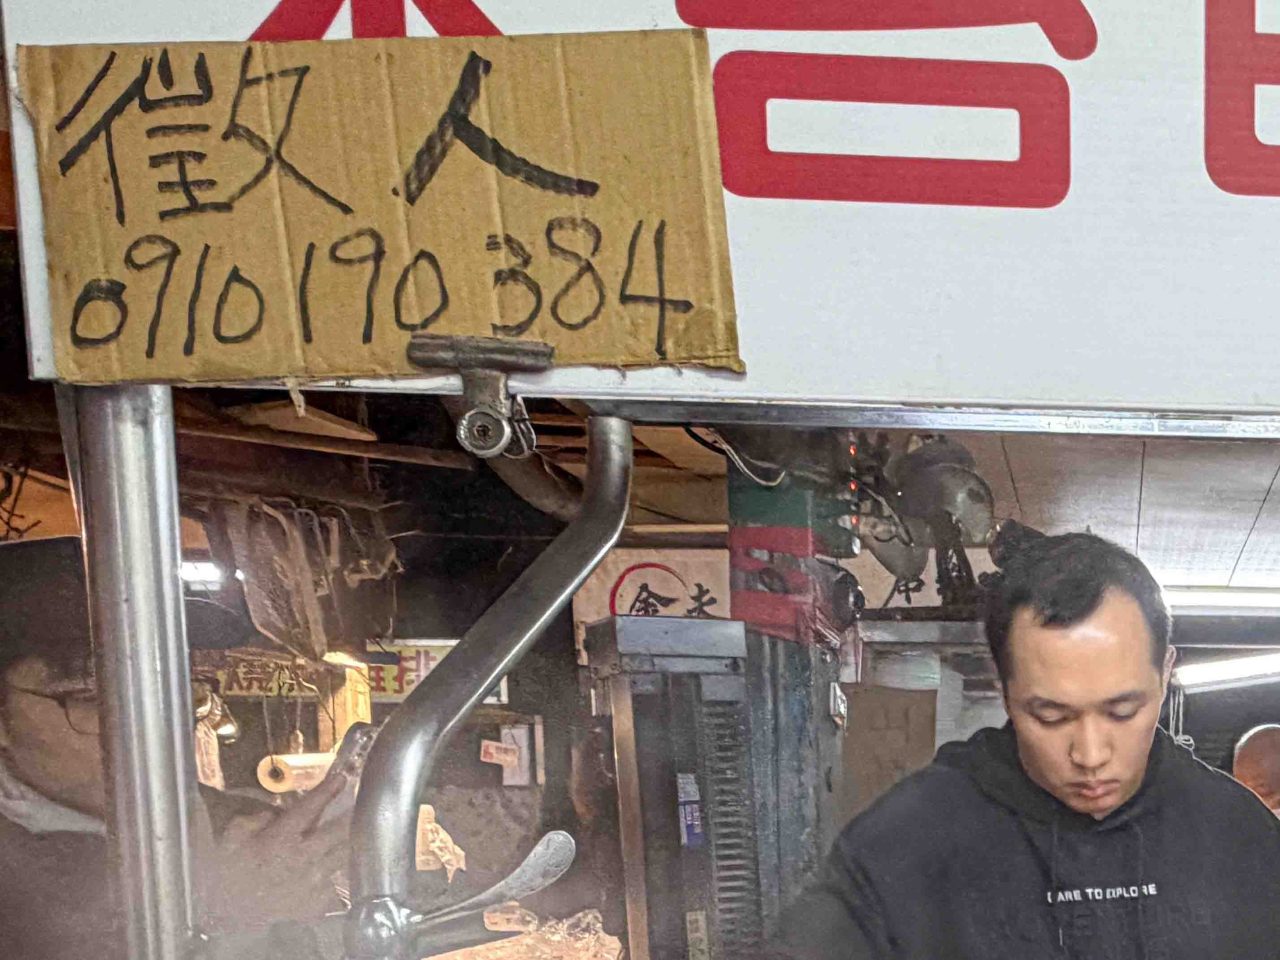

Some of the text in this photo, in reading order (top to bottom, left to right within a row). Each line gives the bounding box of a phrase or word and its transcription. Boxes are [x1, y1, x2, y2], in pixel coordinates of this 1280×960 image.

[70, 235, 265, 359] 0910
[300, 228, 450, 345] 190
[1085, 888, 1103, 900] TO
